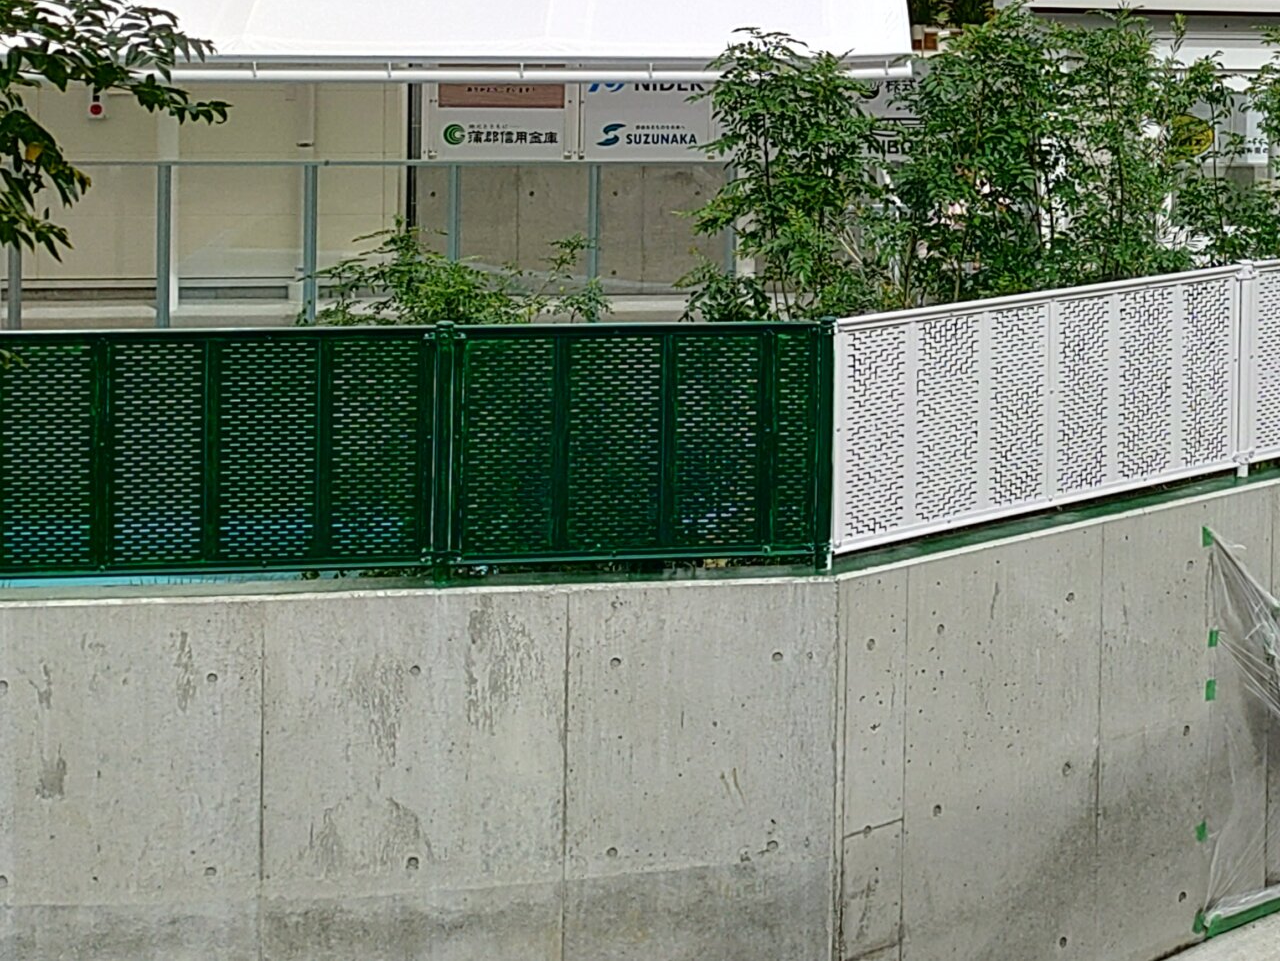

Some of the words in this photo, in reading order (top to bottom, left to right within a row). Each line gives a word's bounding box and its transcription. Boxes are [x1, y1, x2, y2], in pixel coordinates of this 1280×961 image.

[467, 131, 558, 144] 蒲郡信用金庫
[626, 134, 697, 145] SUZUNAKA
